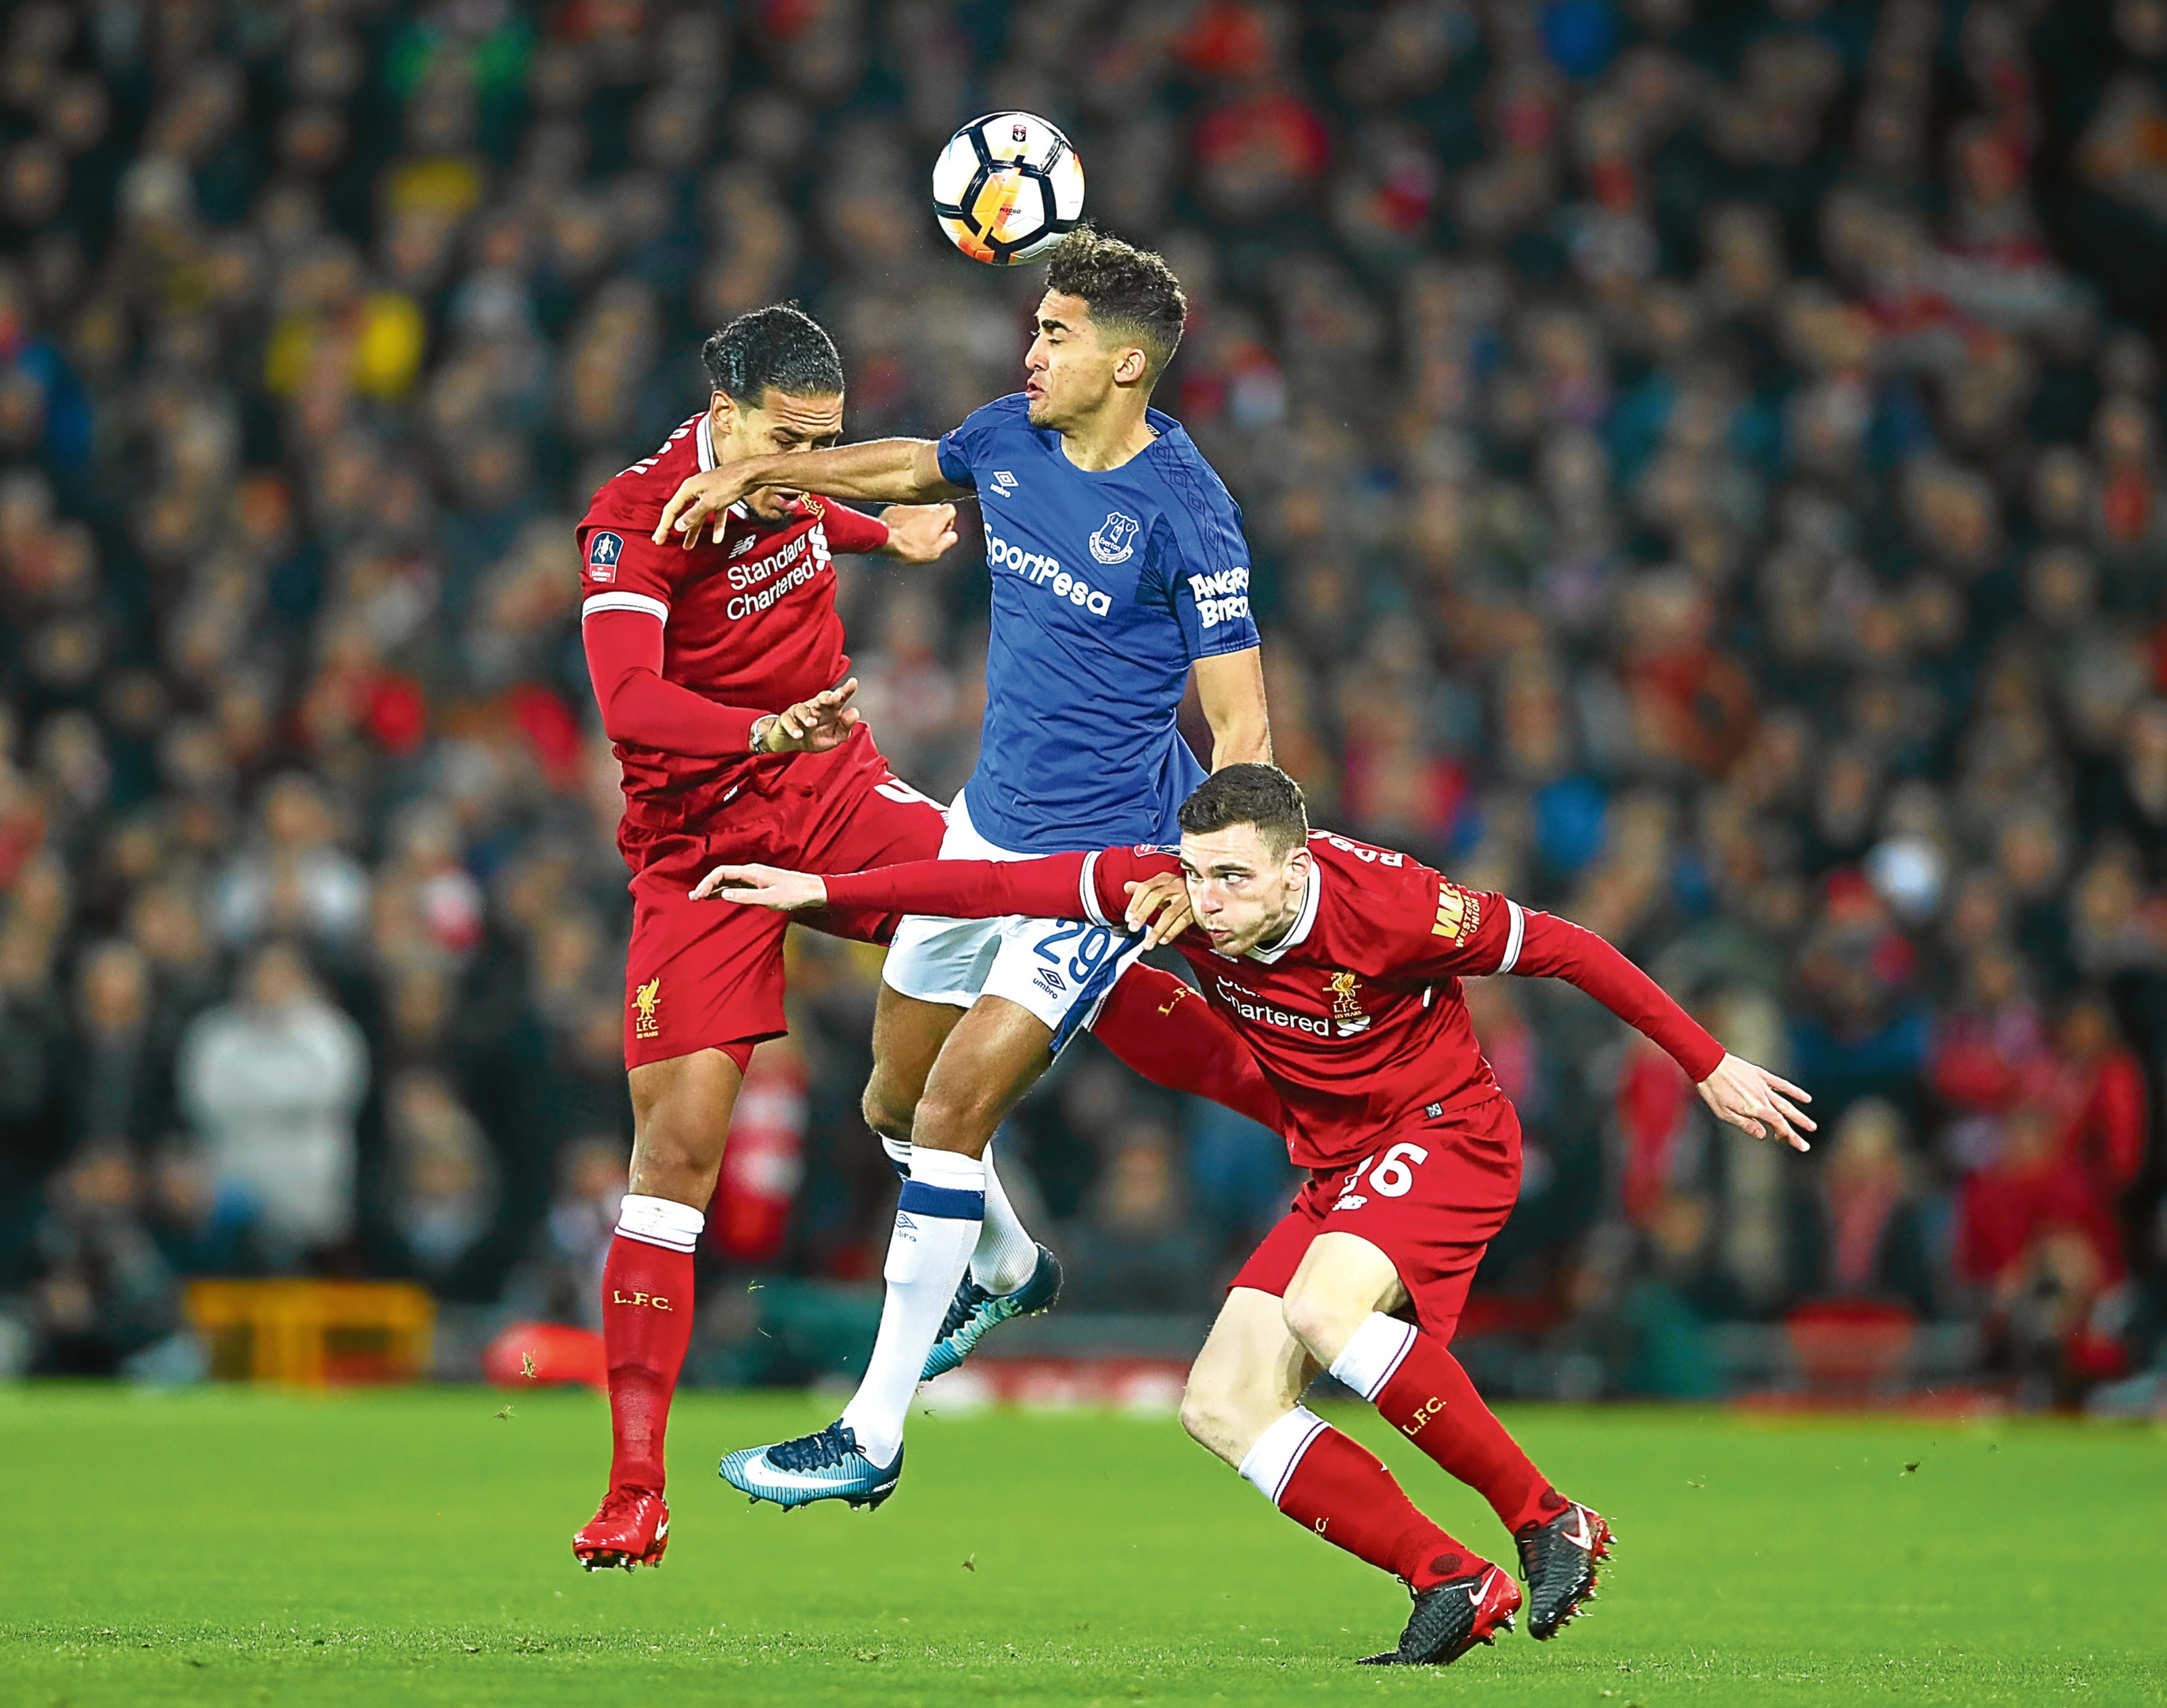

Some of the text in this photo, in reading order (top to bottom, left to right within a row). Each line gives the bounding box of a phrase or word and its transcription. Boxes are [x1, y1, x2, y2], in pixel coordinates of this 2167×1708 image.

[727, 533, 806, 591] Standard
[727, 554, 815, 621] Chartered
[1195, 595, 1250, 629] BIRD
[1454, 894, 1473, 948] WESTERN
[1469, 897, 1481, 933] UNION
[1033, 916, 1111, 984] 29
[1032, 977, 1058, 999] umbro
[613, 1290, 674, 1312] L.F.C.
[1401, 1396, 1448, 1436] L.F.C.
